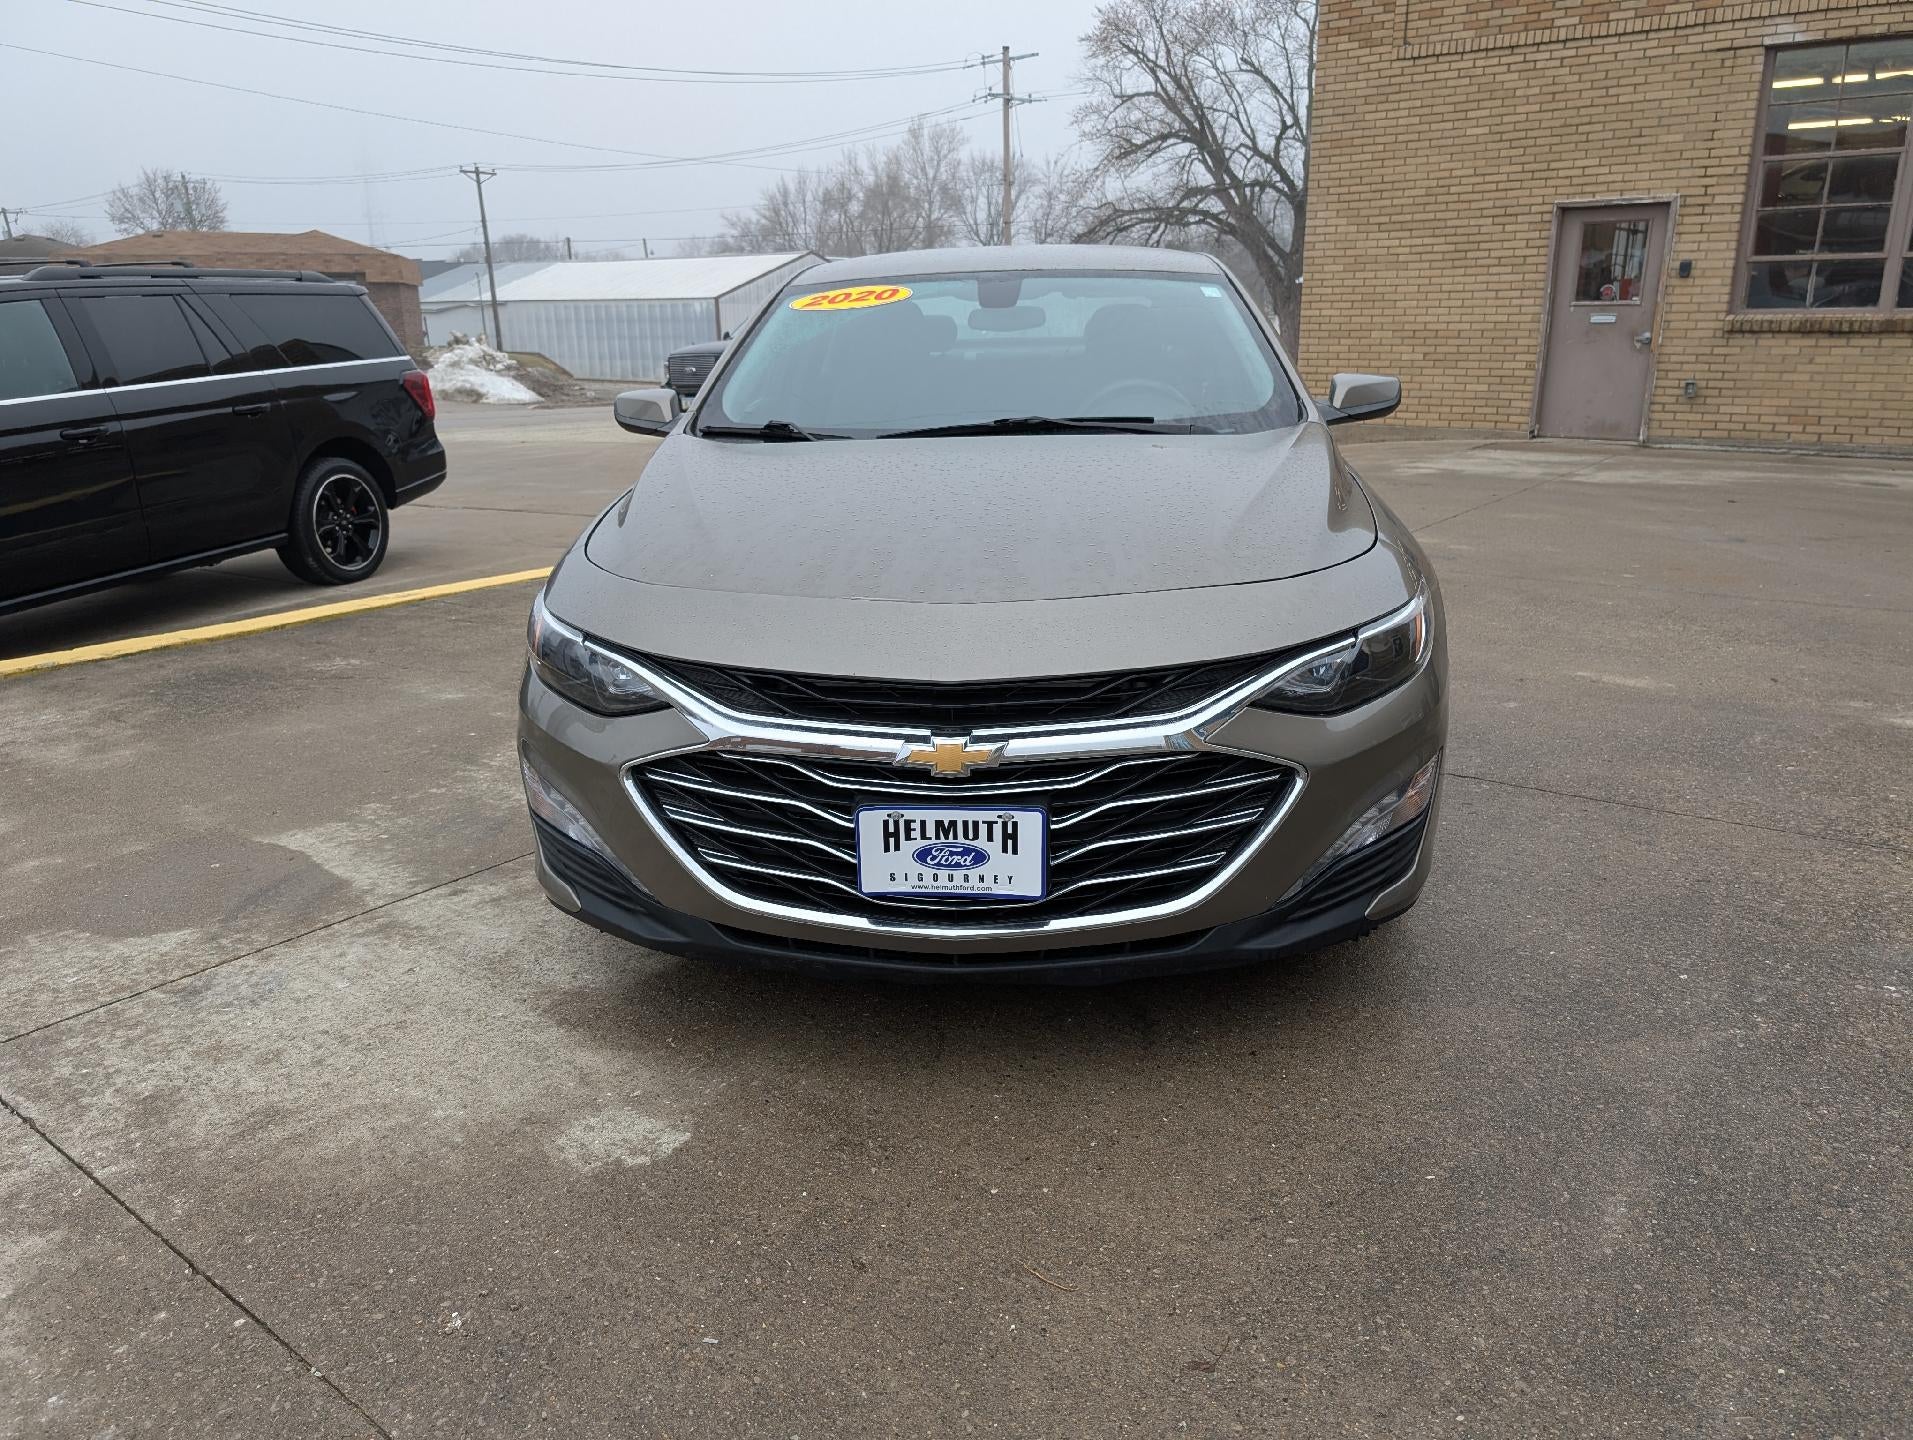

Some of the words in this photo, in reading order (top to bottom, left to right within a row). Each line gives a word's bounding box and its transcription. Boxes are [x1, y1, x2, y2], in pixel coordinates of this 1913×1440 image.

[801, 288, 900, 308] 2020
[882, 819, 1019, 855] HELMUTH
[926, 846, 974, 866] Ford
[889, 872, 1014, 885] SIGOURNEY
[910, 883, 993, 892] www.helmuthford.com
